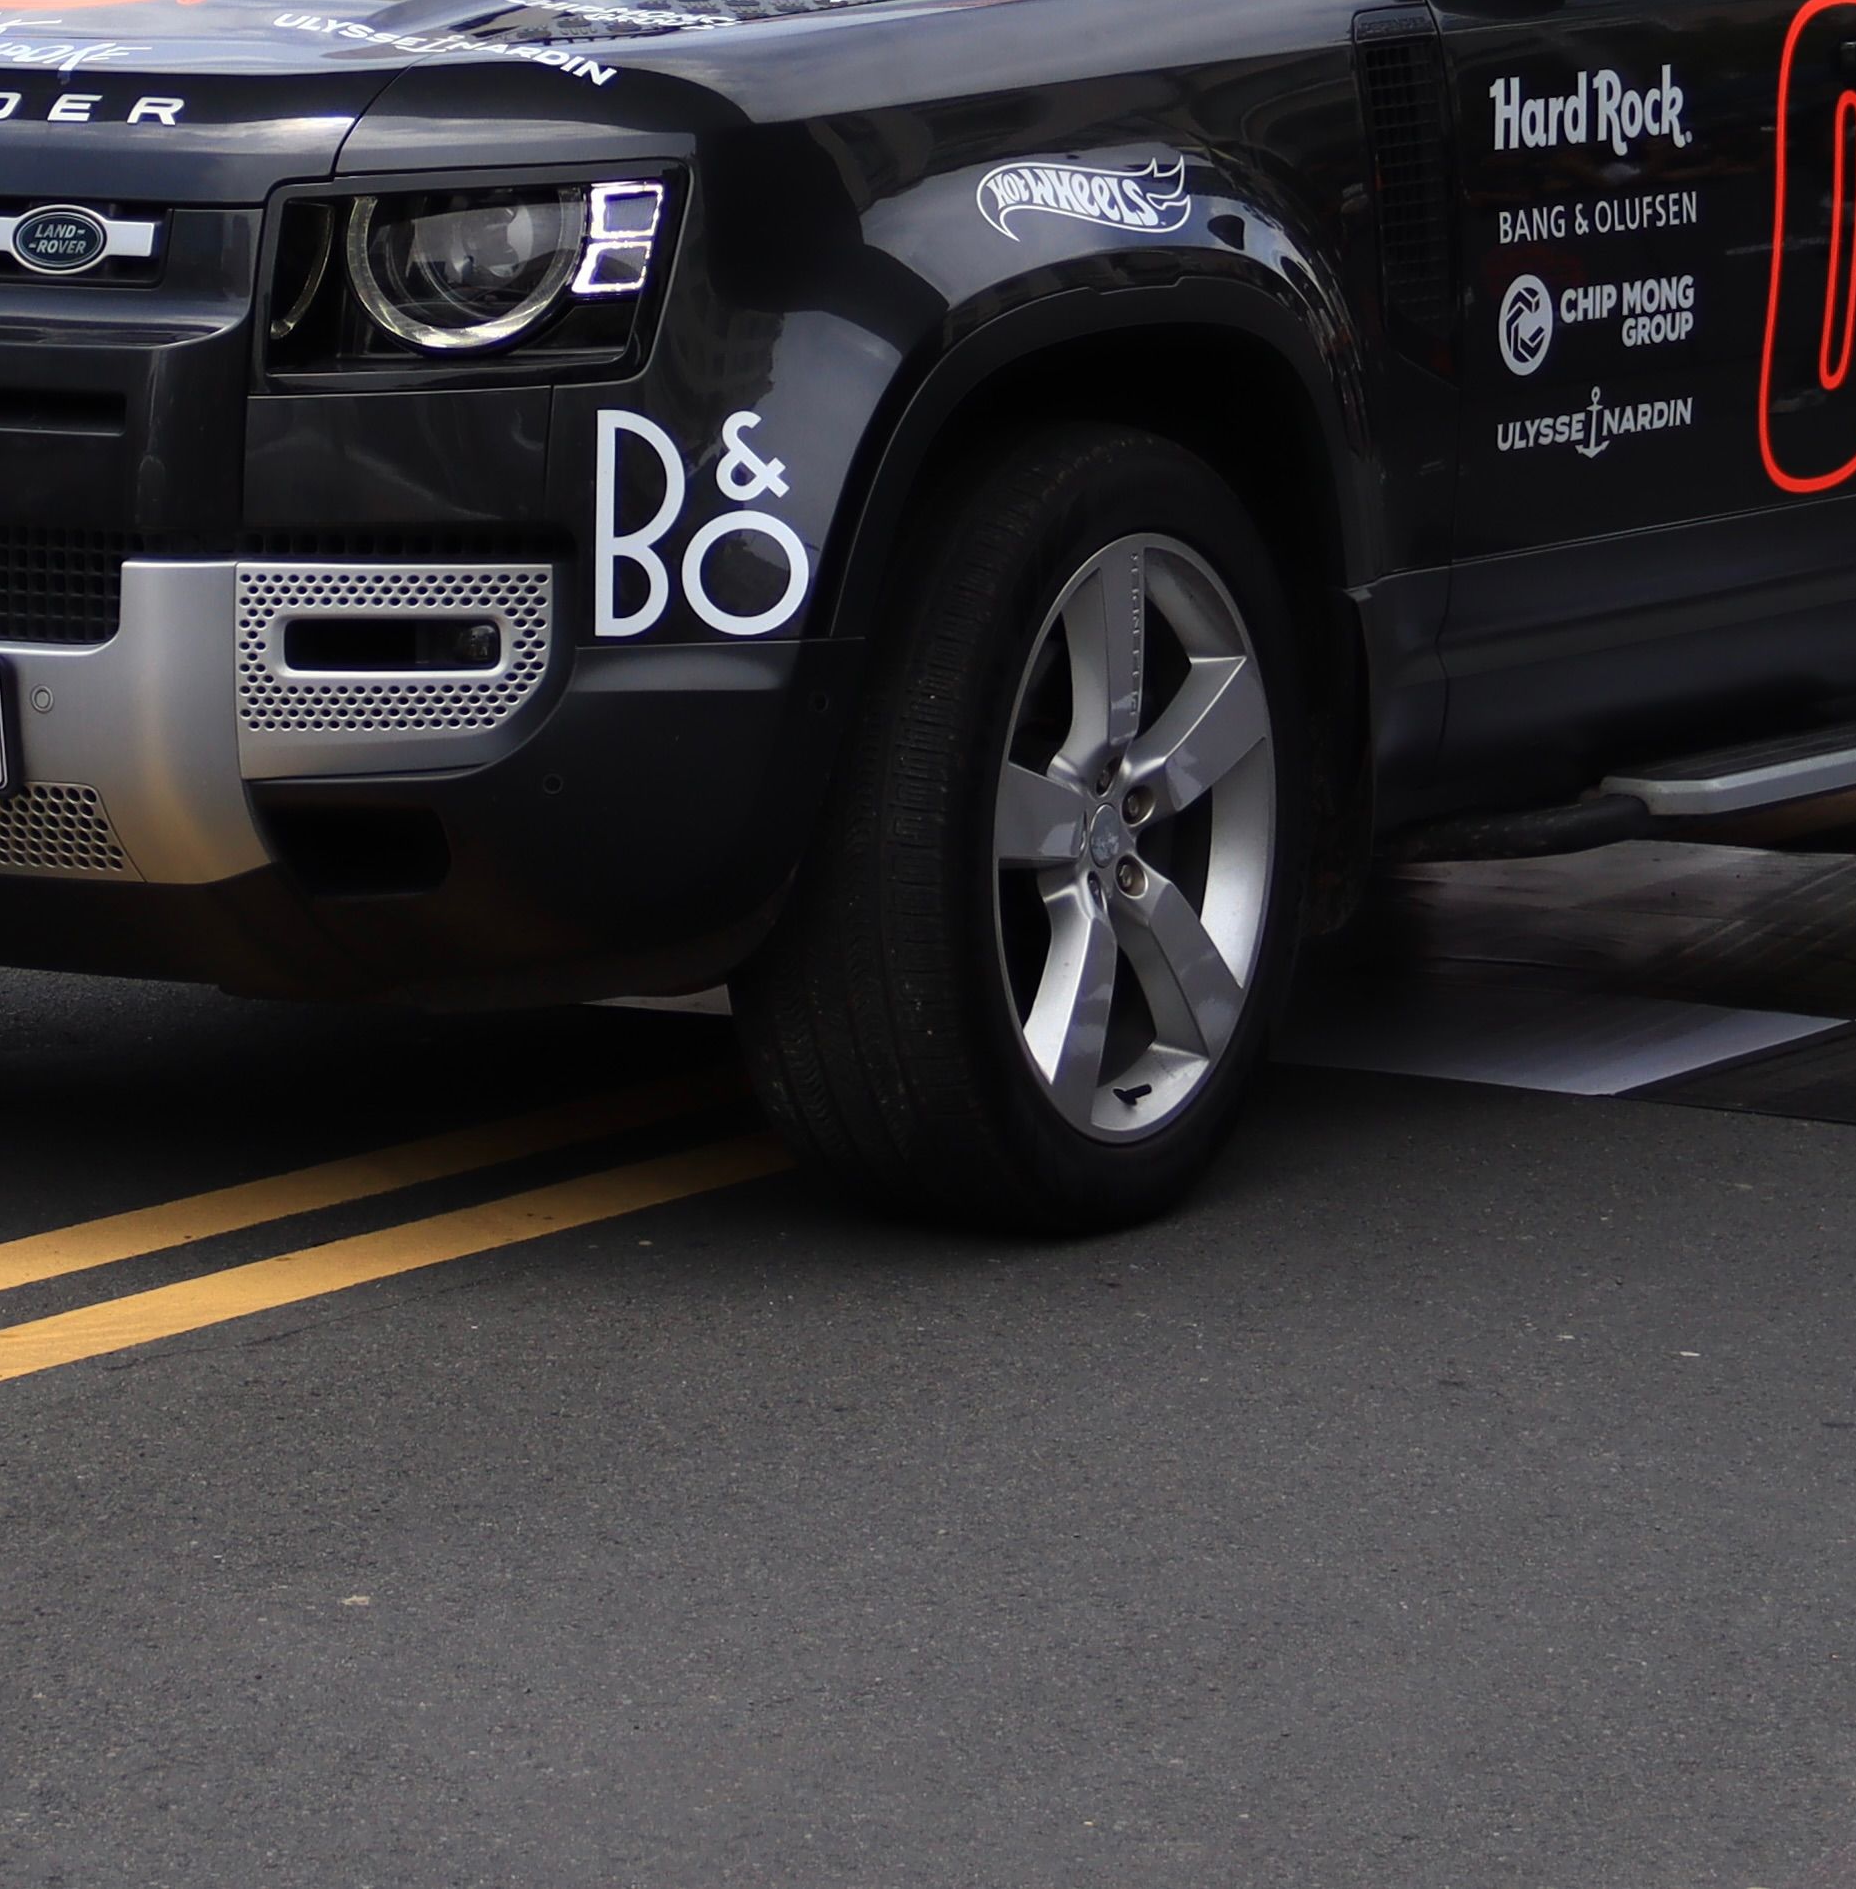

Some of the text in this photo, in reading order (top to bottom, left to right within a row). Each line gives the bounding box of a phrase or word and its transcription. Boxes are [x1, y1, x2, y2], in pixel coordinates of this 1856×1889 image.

[273, 13, 618, 87] ULYSSE NARDIN
[1489, 64, 1686, 157] Hard Rock
[1498, 191, 1697, 244] BANG & OLUFSEN
[1560, 274, 1695, 324] CHIP MONG
[1621, 310, 1694, 348] GROUP
[1496, 397, 1693, 452] ULYSSE NARDIN
